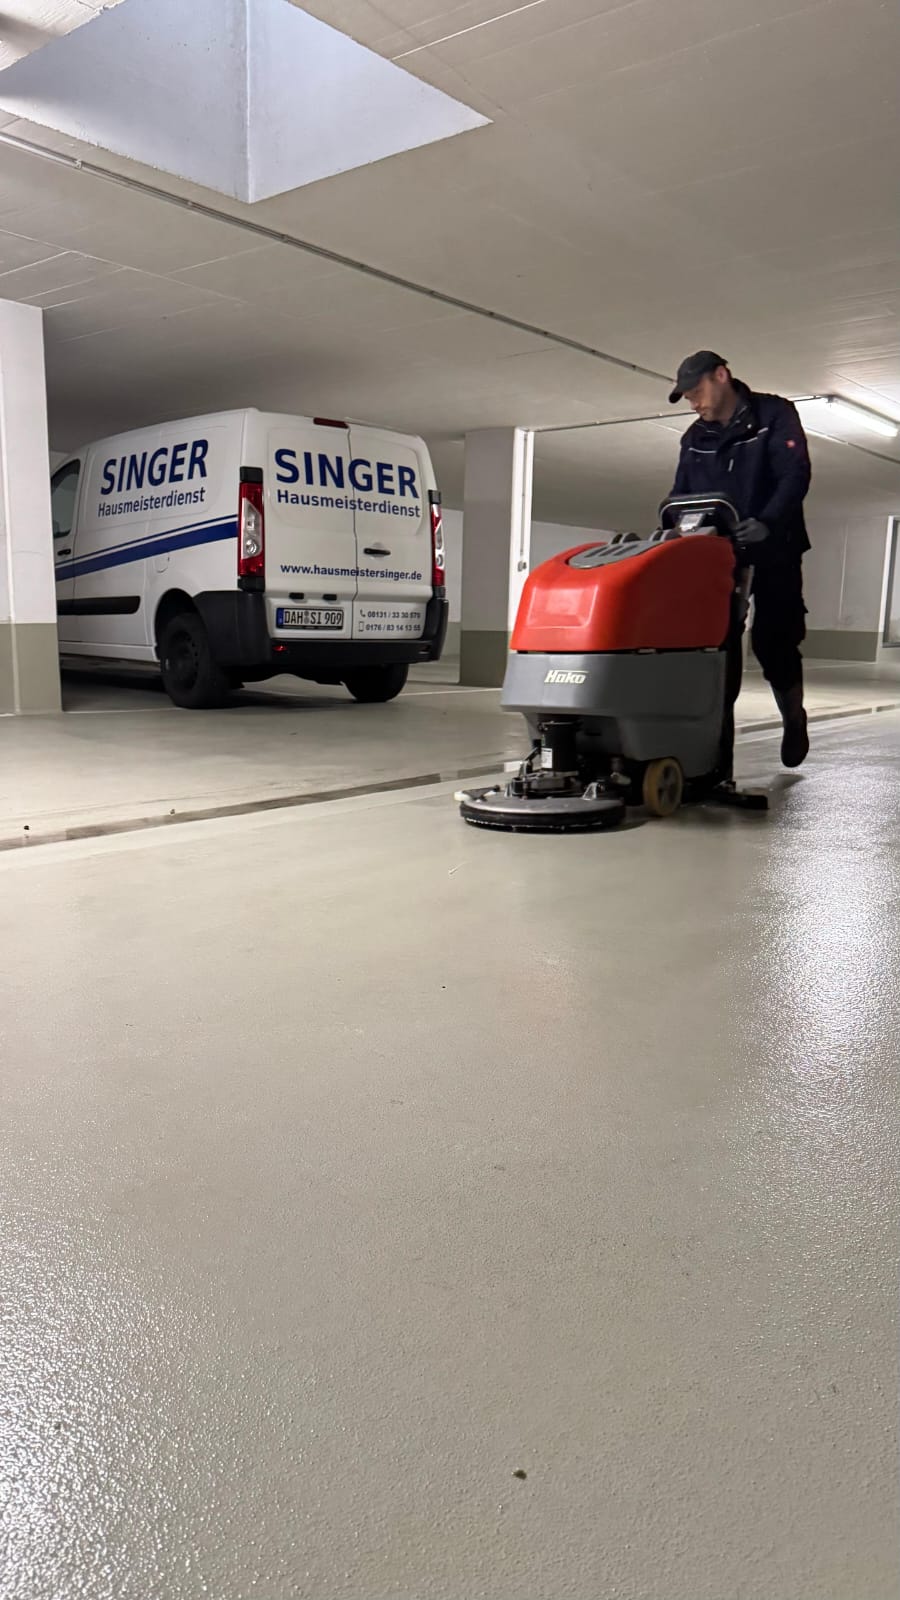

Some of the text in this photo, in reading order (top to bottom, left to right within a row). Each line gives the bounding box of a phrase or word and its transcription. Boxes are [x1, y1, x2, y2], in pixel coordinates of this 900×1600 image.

[101, 439, 209, 495] SINGER
[274, 448, 420, 499] SINGER
[98, 486, 206, 518] Hausmeisterdienst
[277, 489, 421, 518] Hausmeisterdienst
[280, 564, 423, 581] www.hausmeistersinger.de
[284, 610, 342, 625] DAH SI 909
[544, 669, 588, 684] Hako
